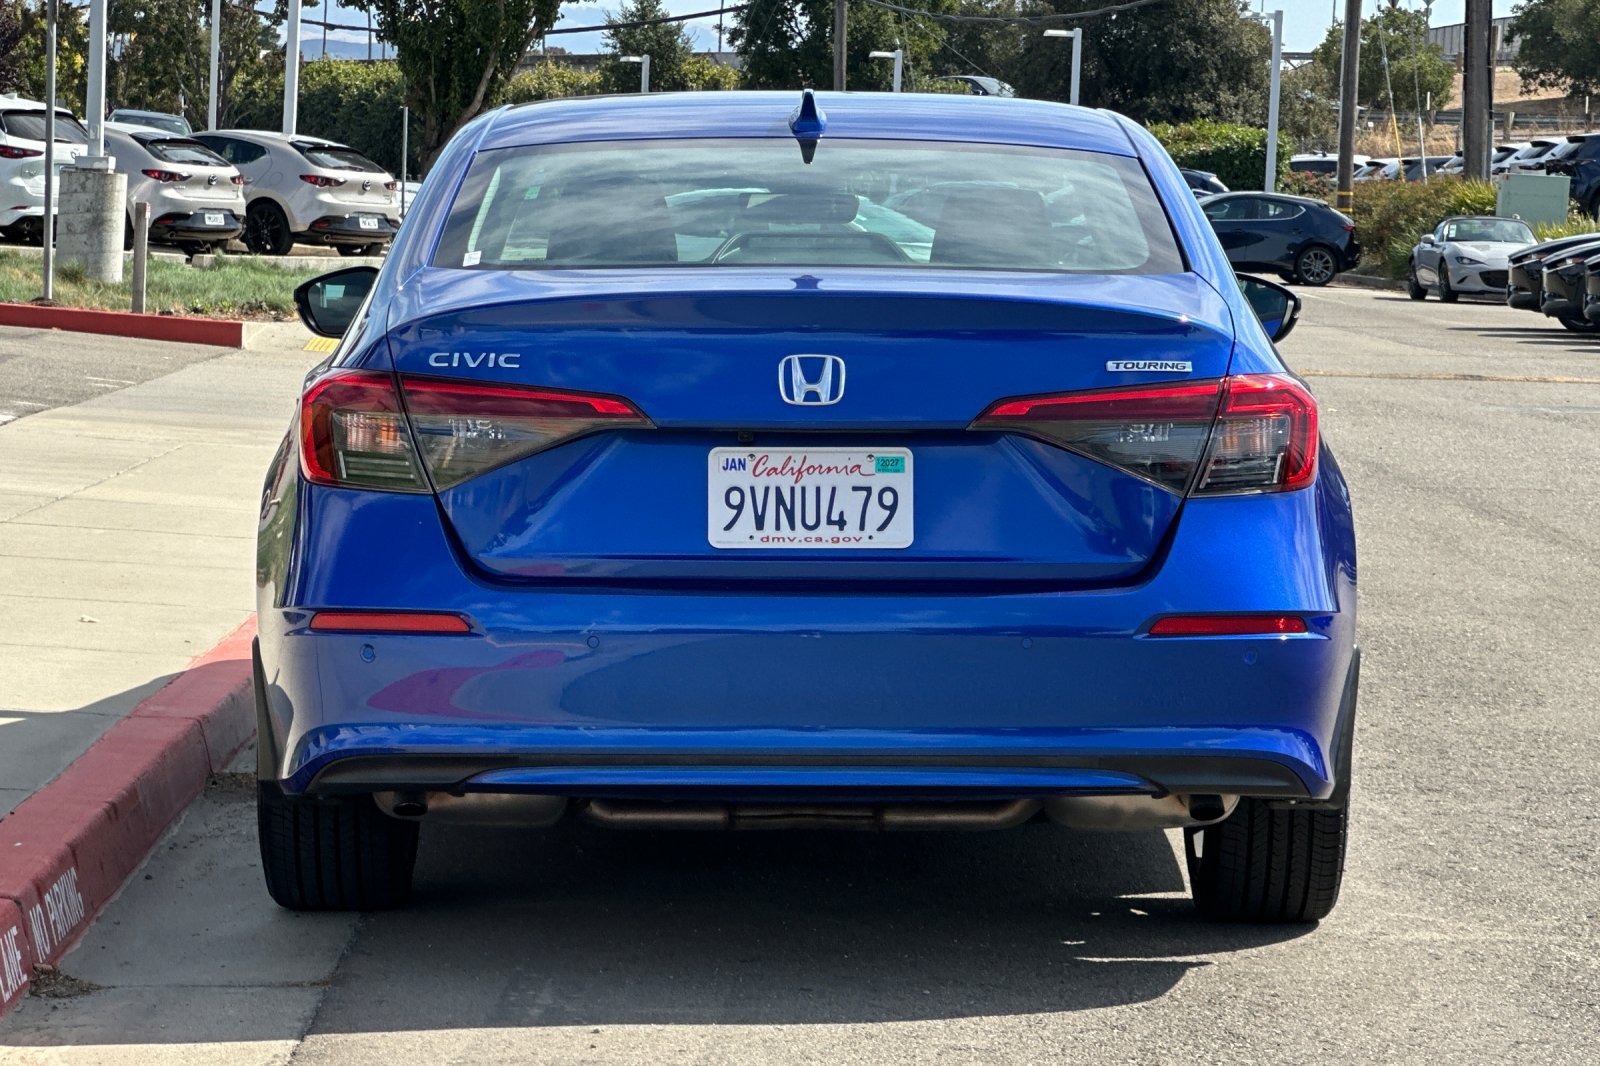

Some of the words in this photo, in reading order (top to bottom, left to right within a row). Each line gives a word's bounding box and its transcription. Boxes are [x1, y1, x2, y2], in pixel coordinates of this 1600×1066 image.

[428, 352, 521, 368] CIVIC
[1112, 361, 1187, 371] TOURING
[722, 457, 747, 471] JAN
[752, 454, 876, 484] California
[880, 458, 900, 467] 2027
[722, 485, 899, 532] 9VNU479
[760, 535, 863, 544] dmv.ca.gov
[29, 903, 51, 963] NO
[44, 866, 85, 946] PARKING
